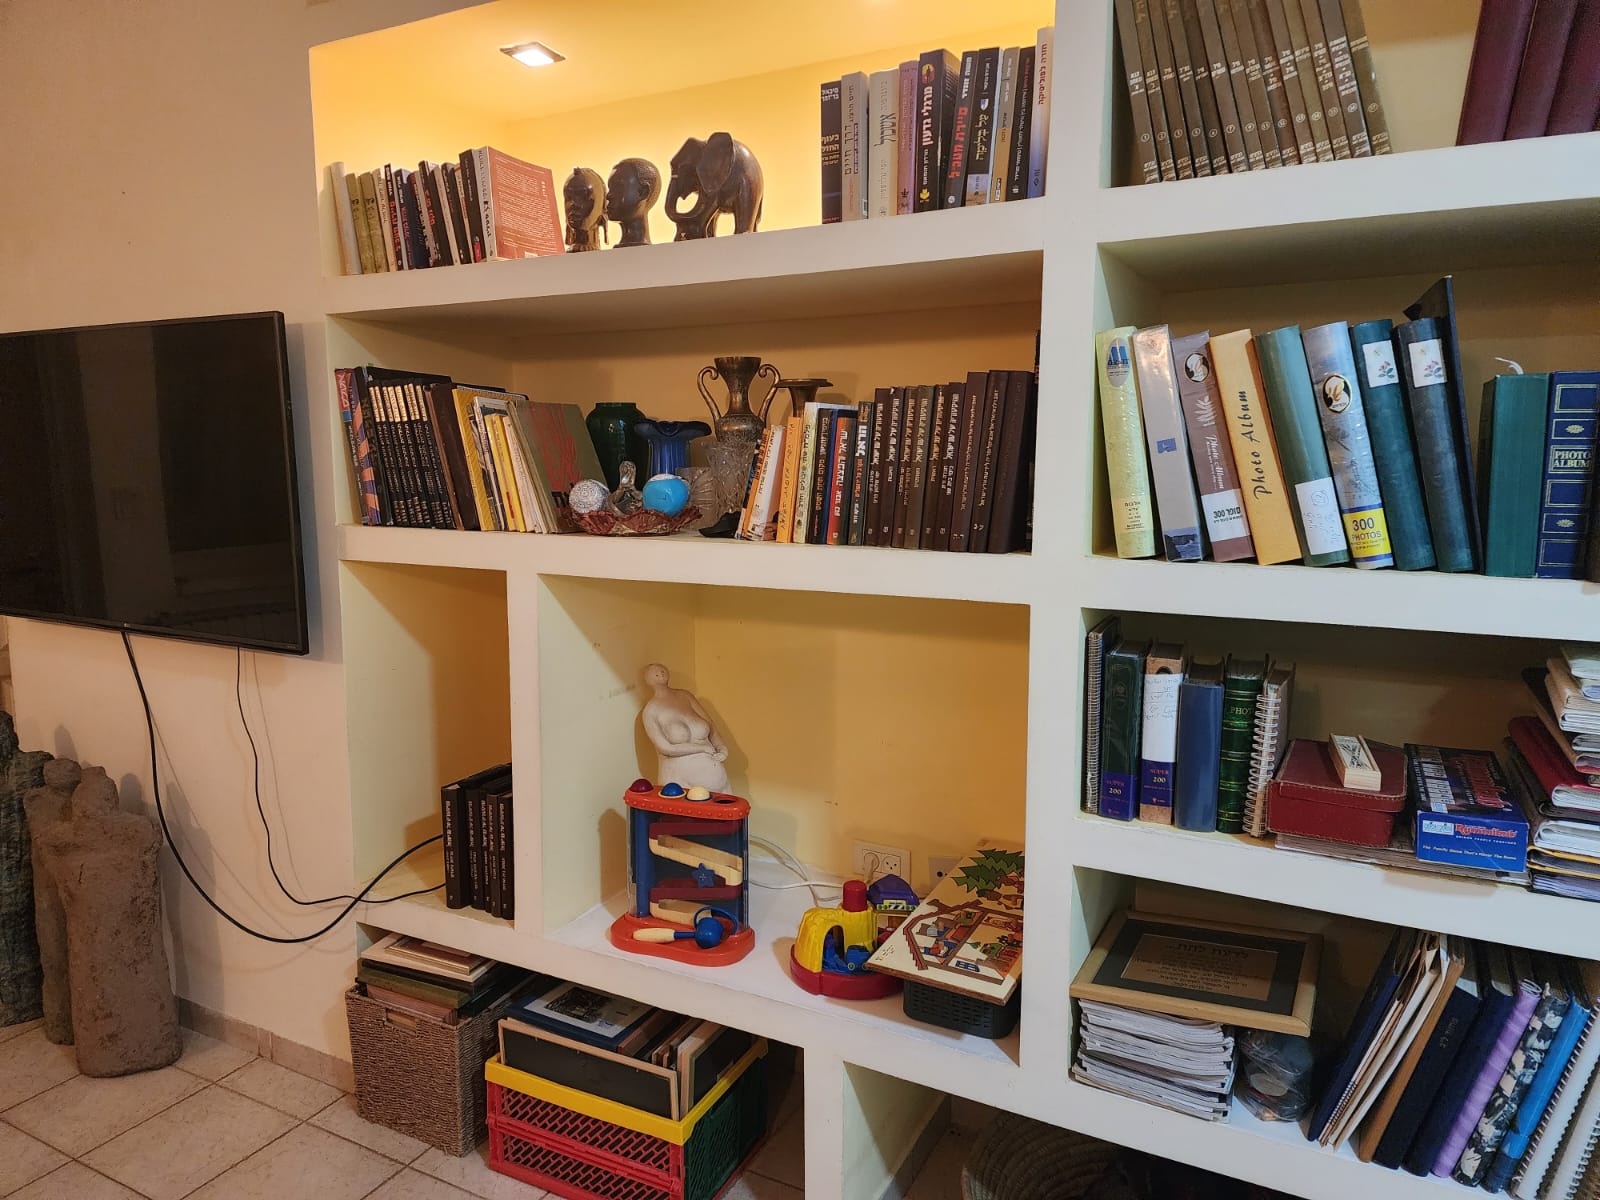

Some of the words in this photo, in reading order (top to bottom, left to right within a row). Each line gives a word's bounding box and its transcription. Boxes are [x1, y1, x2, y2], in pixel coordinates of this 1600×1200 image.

[1040, 44, 1048, 63] חזרה
[1037, 66, 1047, 105] לפוליטיקה
[921, 86, 933, 115] מרגלי
[874, 112, 897, 147] אשכול
[921, 118, 934, 146] גדעון
[954, 106, 968, 141] סיירת
[975, 114, 989, 128] על
[844, 124, 854, 144] דרך
[844, 150, 852, 175] חיים
[337, 372, 349, 407] אטלס
[1239, 389, 1260, 443] Album
[837, 428, 848, 453] ישראל
[855, 425, 867, 457] הראל
[1553, 459, 1590, 468] ALBUM
[1554, 450, 1592, 460] PHOTO
[836, 456, 847, 486] והפצצה
[1251, 449, 1273, 500] Photo
[815, 492, 823, 510] השמש
[1213, 509, 1225, 519] 300
[1352, 517, 1374, 531] 300
[1351, 530, 1382, 541] PHOTOS
[1230, 706, 1254, 716] PHOT
